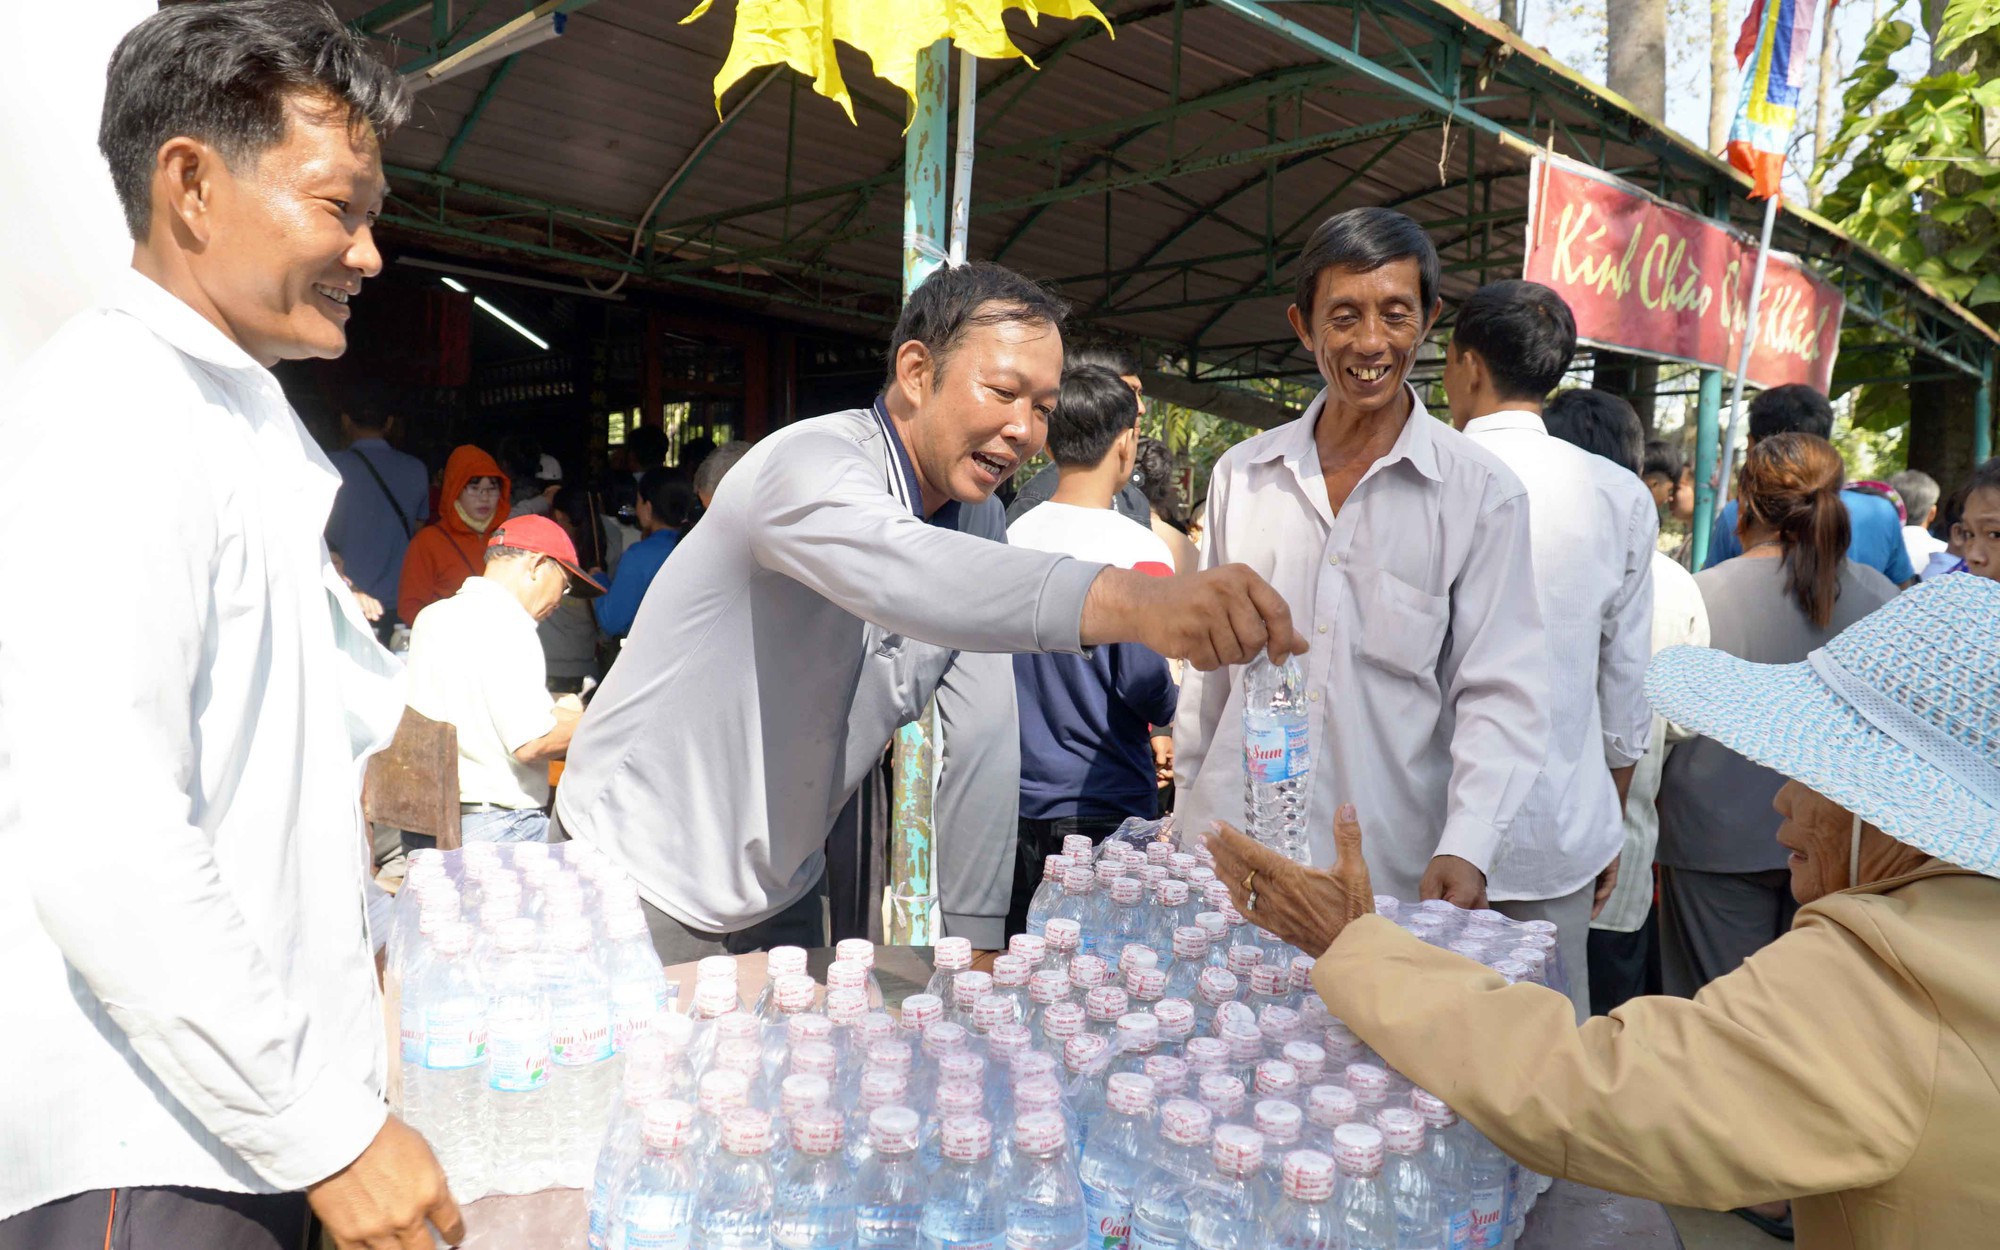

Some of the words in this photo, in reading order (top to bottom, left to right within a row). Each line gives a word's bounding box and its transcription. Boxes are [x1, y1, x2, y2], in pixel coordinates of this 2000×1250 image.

[1552, 202, 1643, 300] Kính
[1639, 233, 1713, 318] Chào
[1254, 744, 1283, 760] Sun
[1471, 1208, 1500, 1227] Sun
